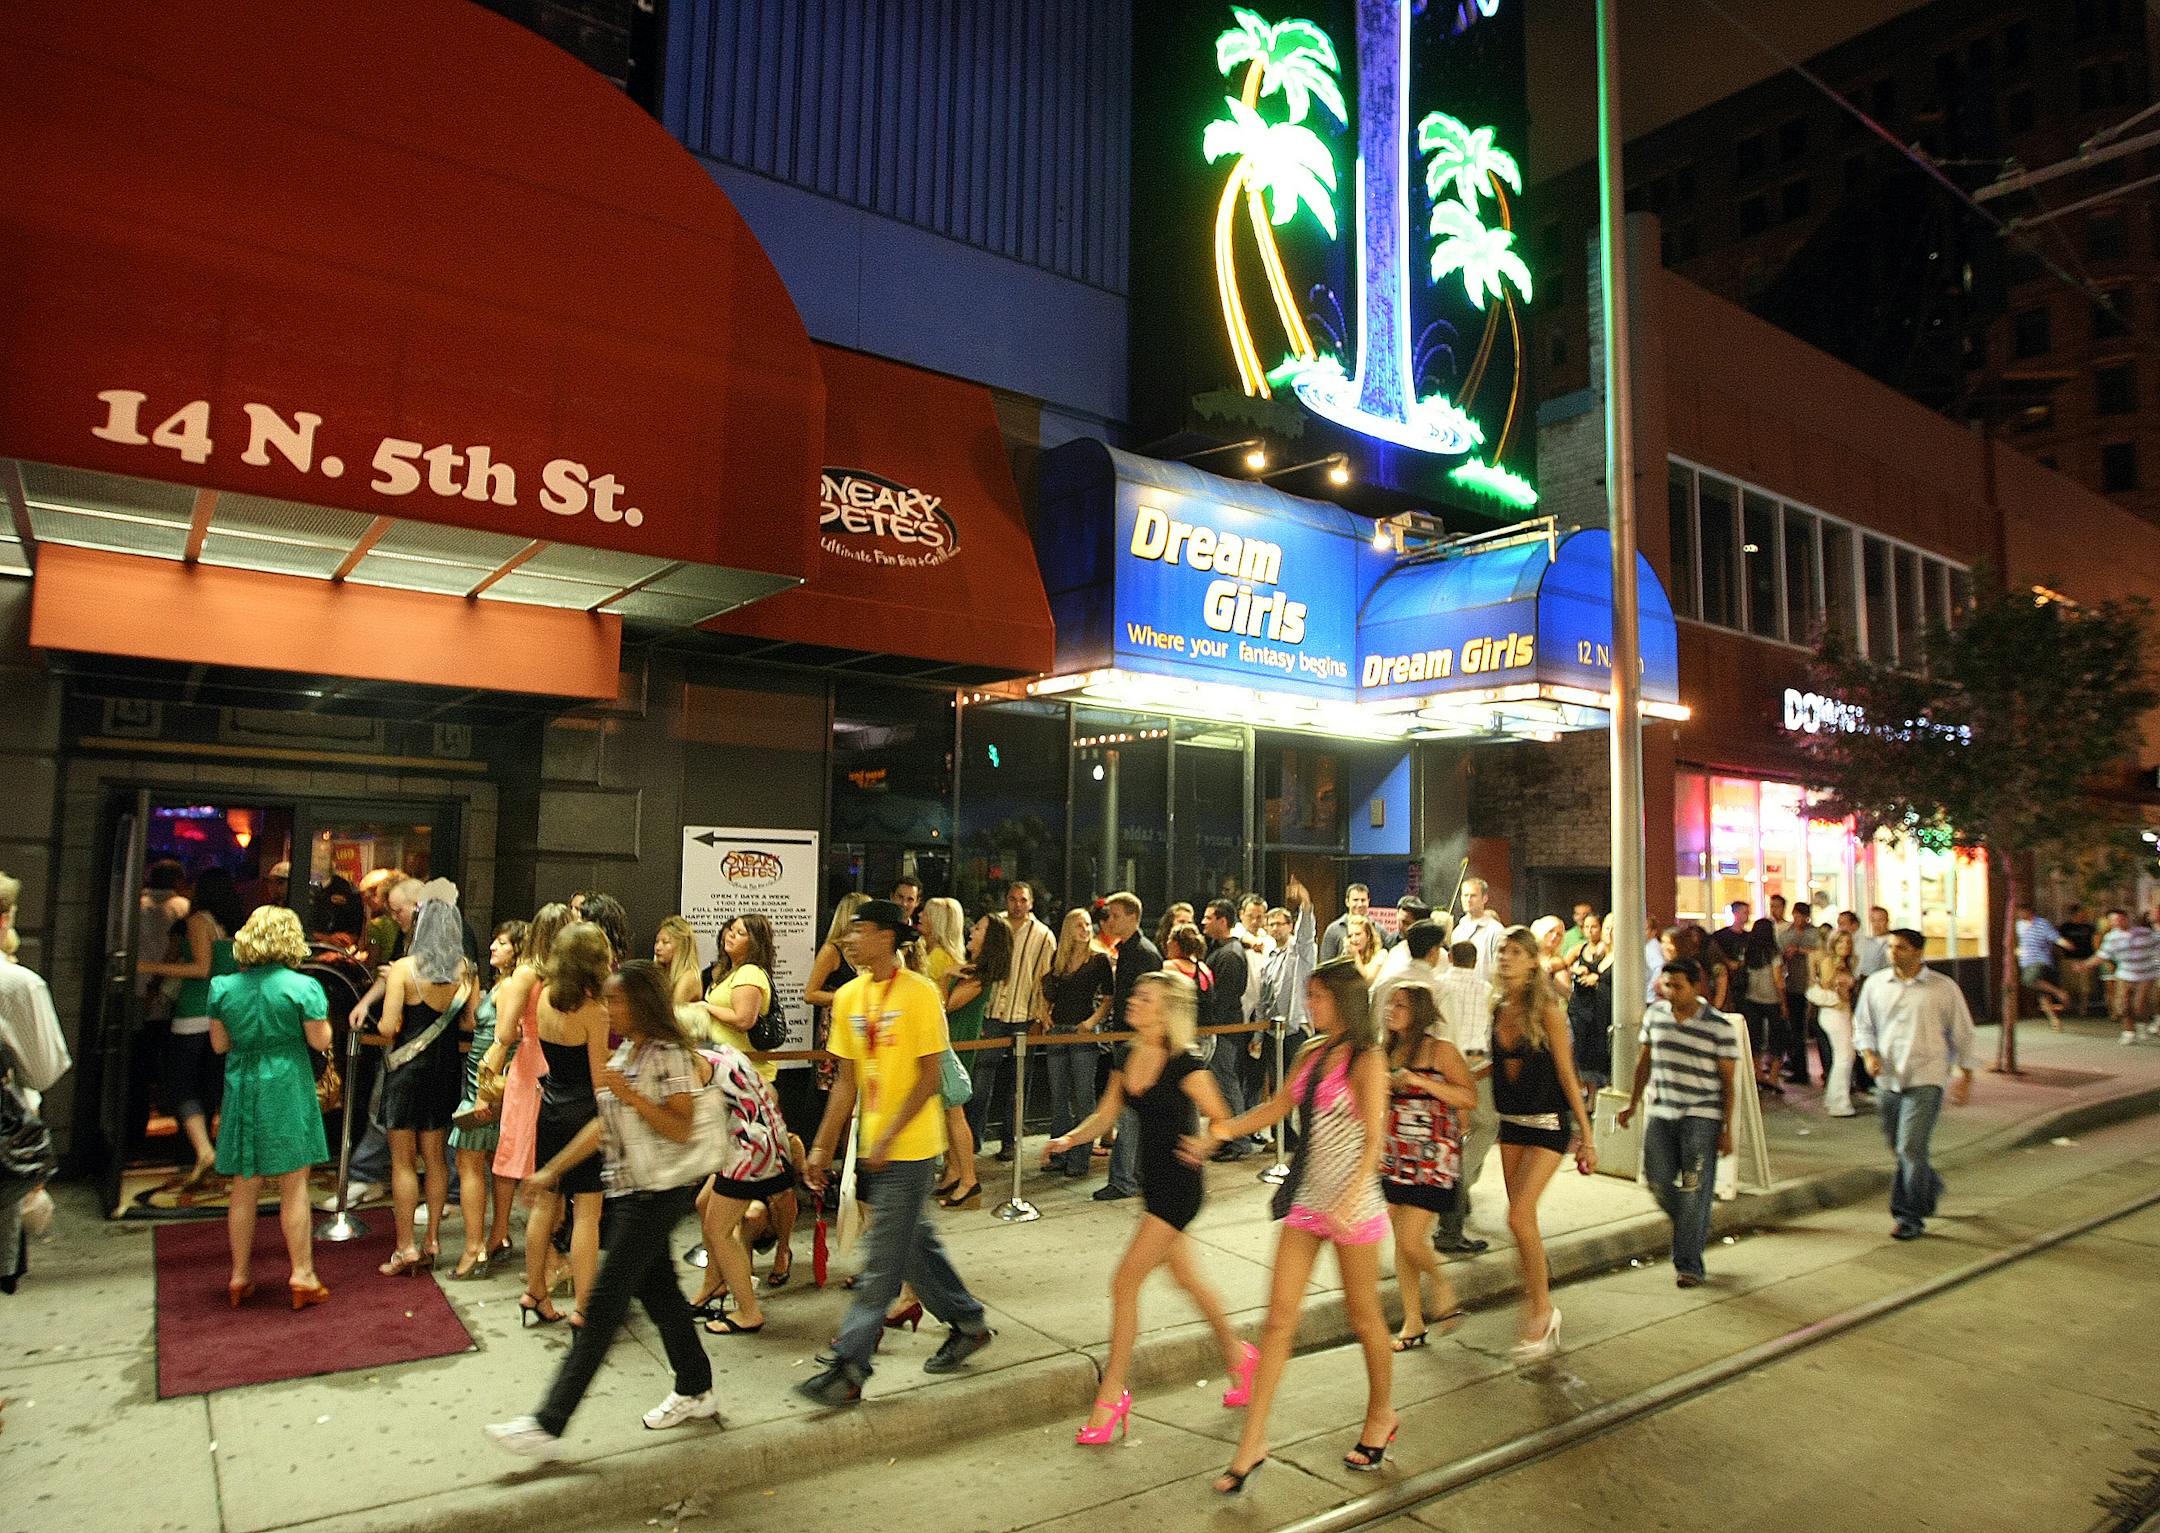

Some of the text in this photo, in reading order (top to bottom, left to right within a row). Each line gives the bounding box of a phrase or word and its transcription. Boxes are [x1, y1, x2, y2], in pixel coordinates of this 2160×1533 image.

[92, 389, 644, 528] 14 N. 5th St.
[820, 473, 942, 522] NEAKY
[1130, 504, 1282, 585] Dream
[1203, 579, 1308, 645] Girls
[1127, 623, 1348, 679] Where your fantasy begins
[1362, 632, 1534, 689] Dream Girls
[1578, 639, 1592, 666] 12
